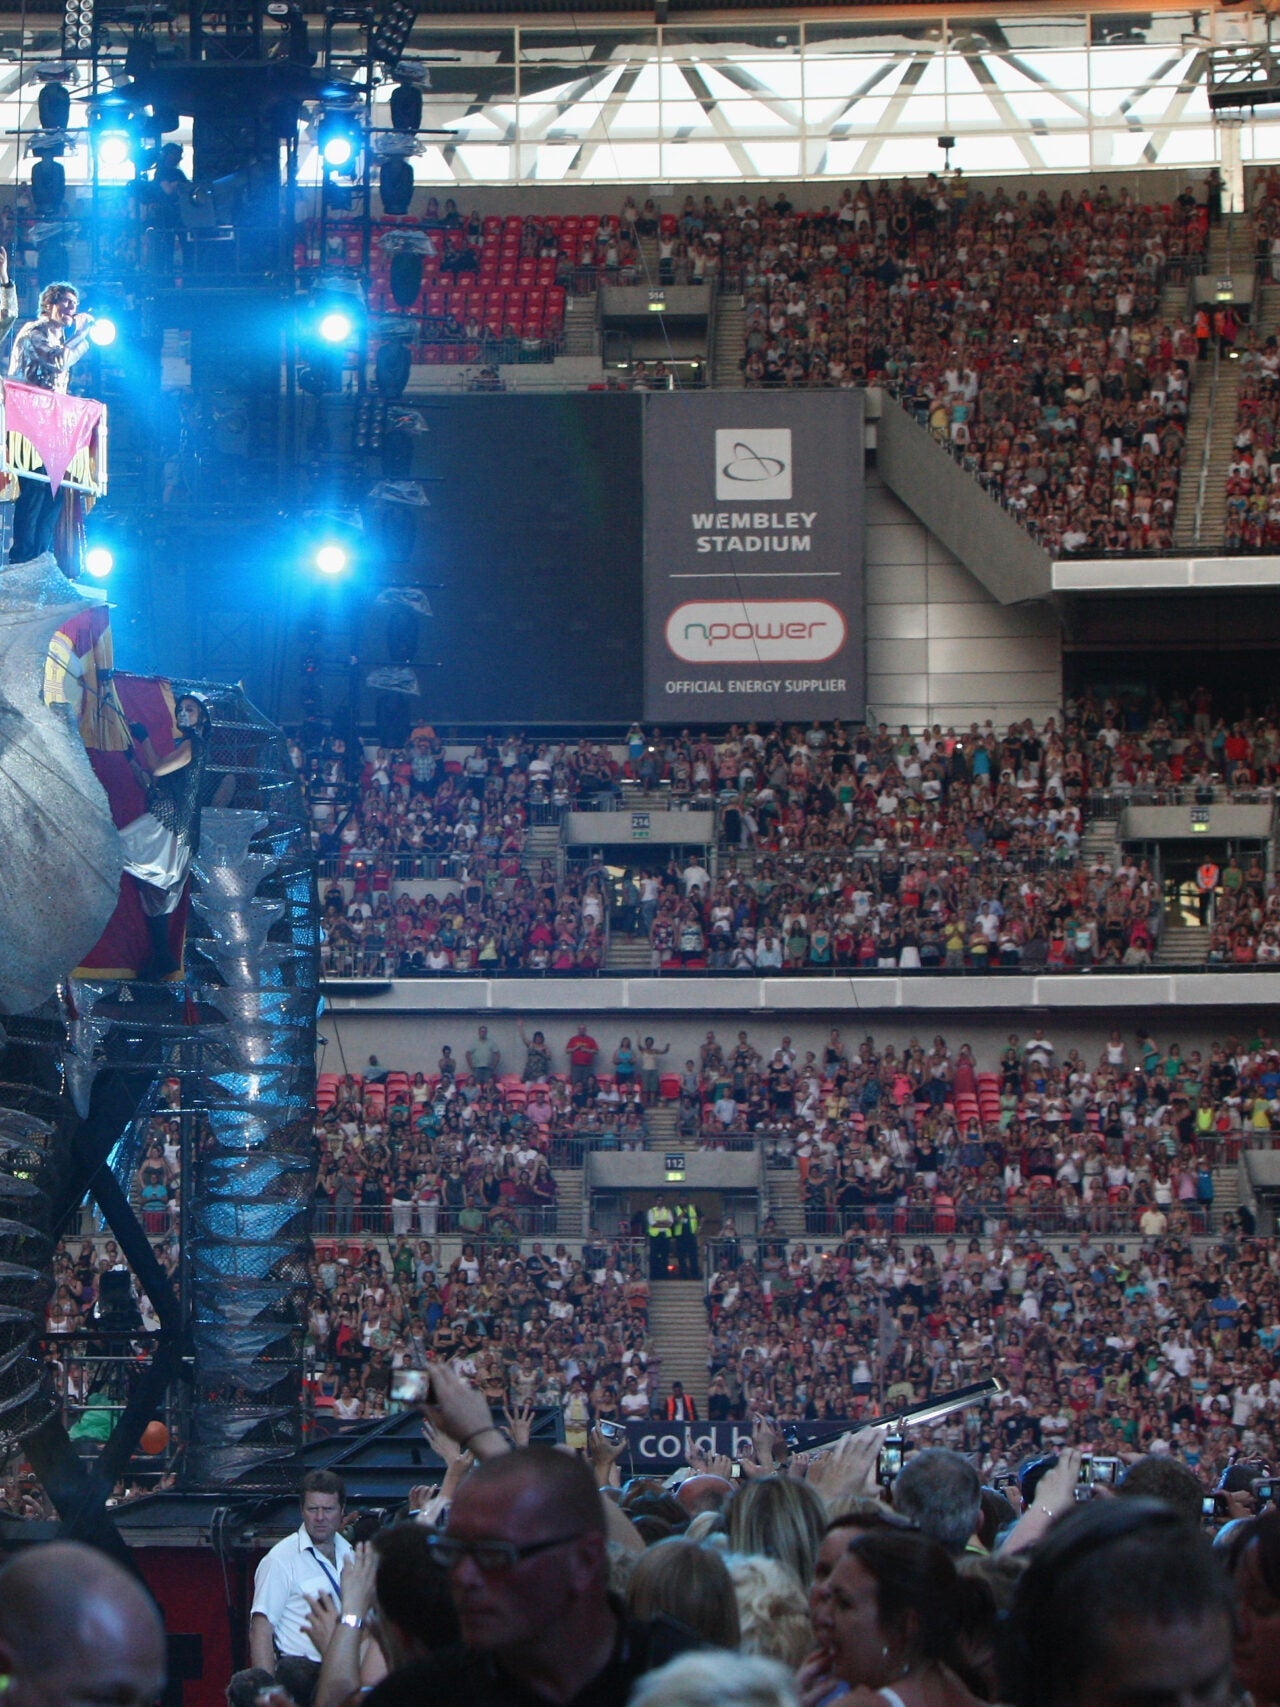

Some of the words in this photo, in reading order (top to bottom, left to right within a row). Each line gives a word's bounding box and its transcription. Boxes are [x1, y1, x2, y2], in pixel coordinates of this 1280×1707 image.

[691, 512, 818, 530] WEMBLEY
[697, 535, 811, 553] STADIUM
[684, 622, 827, 646] npower
[665, 680, 725, 694] OFFICIAL
[728, 680, 781, 693] ENERGY
[785, 679, 846, 692] SUPPLIER
[632, 818, 649, 827] 214
[666, 1159, 685, 1168] 112
[638, 1426, 717, 1458] cold
